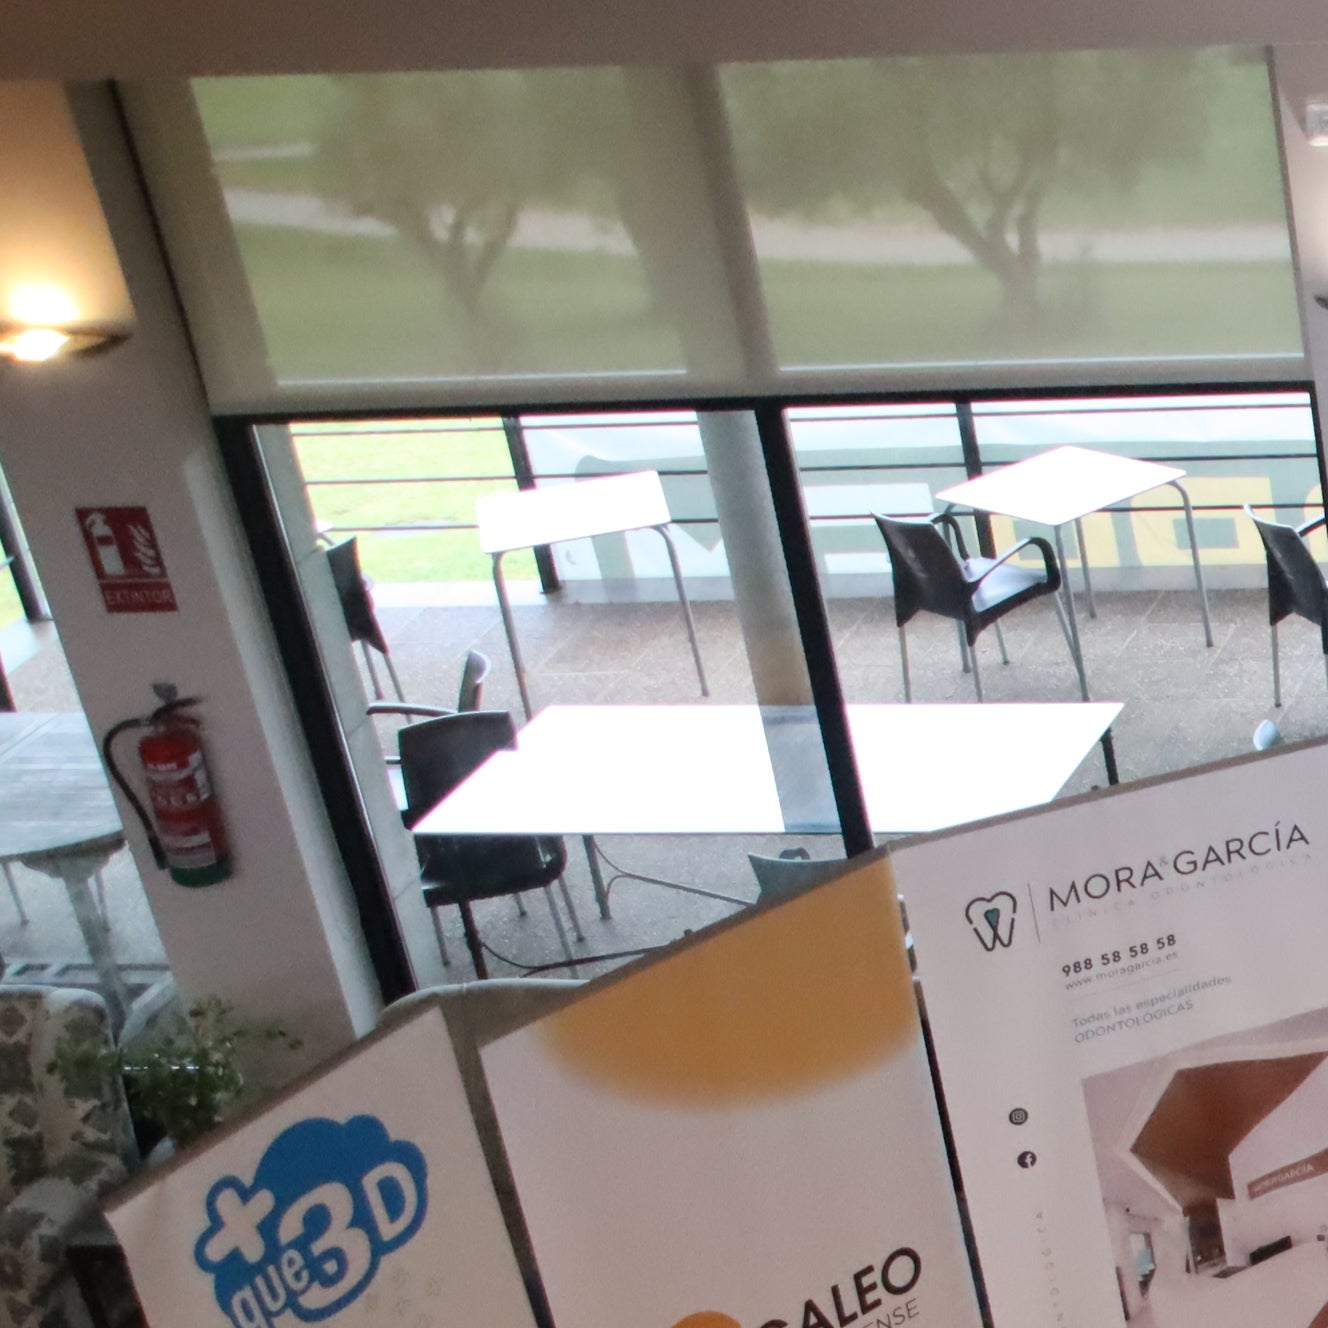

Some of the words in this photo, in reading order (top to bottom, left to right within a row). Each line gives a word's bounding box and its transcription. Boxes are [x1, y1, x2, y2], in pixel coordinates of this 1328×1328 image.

[106, 589, 173, 604] EXTINTOR
[1045, 857, 1164, 912] MORA
[1172, 821, 1310, 876] GARCÍA
[1061, 957, 1093, 977] 988
[1100, 949, 1121, 966] 58
[1128, 941, 1149, 958] 58
[1155, 933, 1176, 950] 58
[1071, 1009, 1109, 1028] Todas
[1113, 1002, 1132, 1016] las
[1134, 972, 1232, 1012] especialidades
[1072, 998, 1193, 1044] ODONTOLÓGICAS
